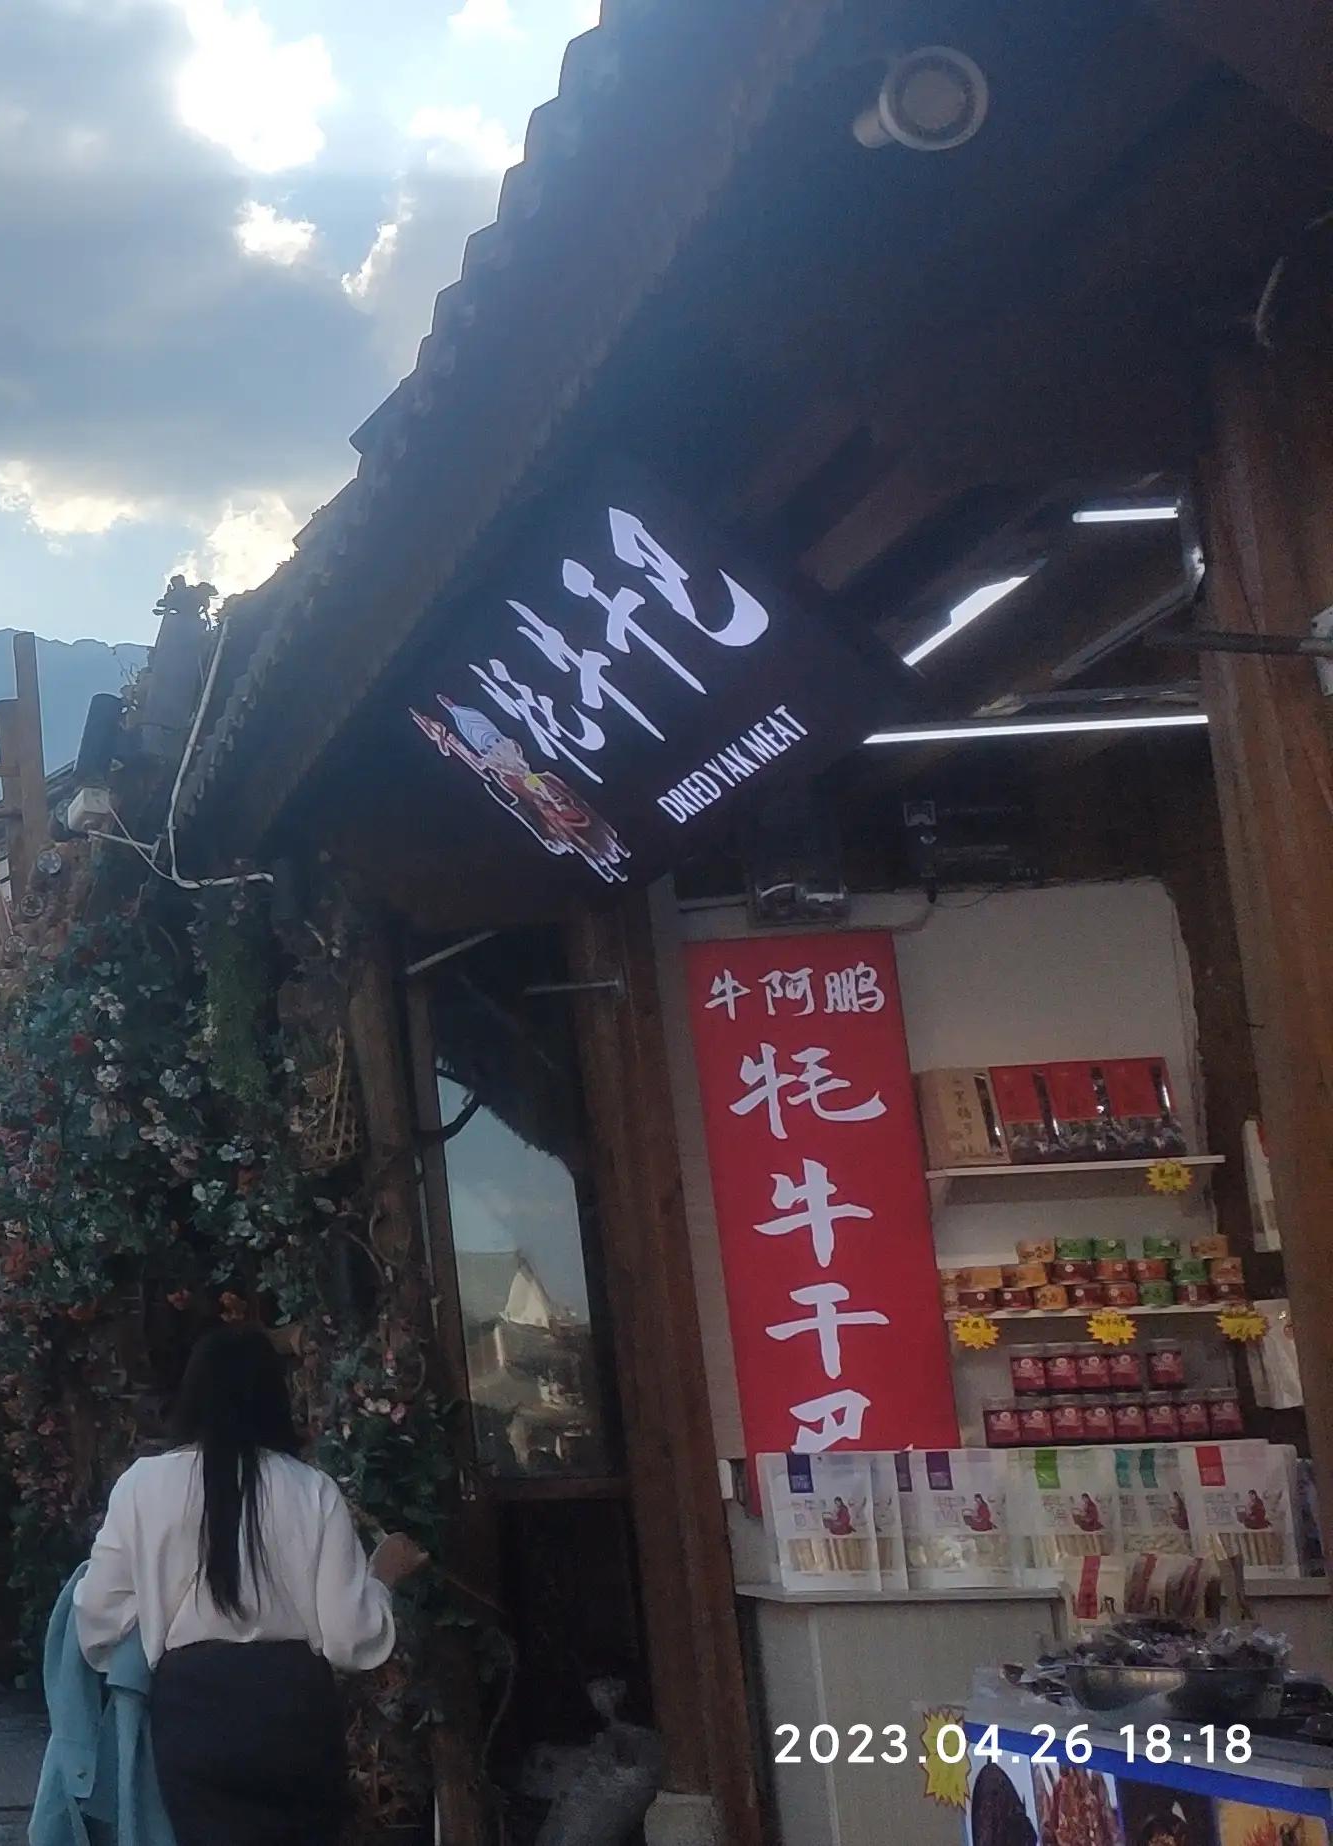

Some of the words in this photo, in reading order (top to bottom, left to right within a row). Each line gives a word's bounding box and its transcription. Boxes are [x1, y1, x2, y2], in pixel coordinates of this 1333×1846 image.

[657, 771, 721, 823] DRIED
[704, 743, 760, 787] YAK
[740, 705, 808, 764] MEAT
[704, 961, 885, 1020] 牛阿鹏
